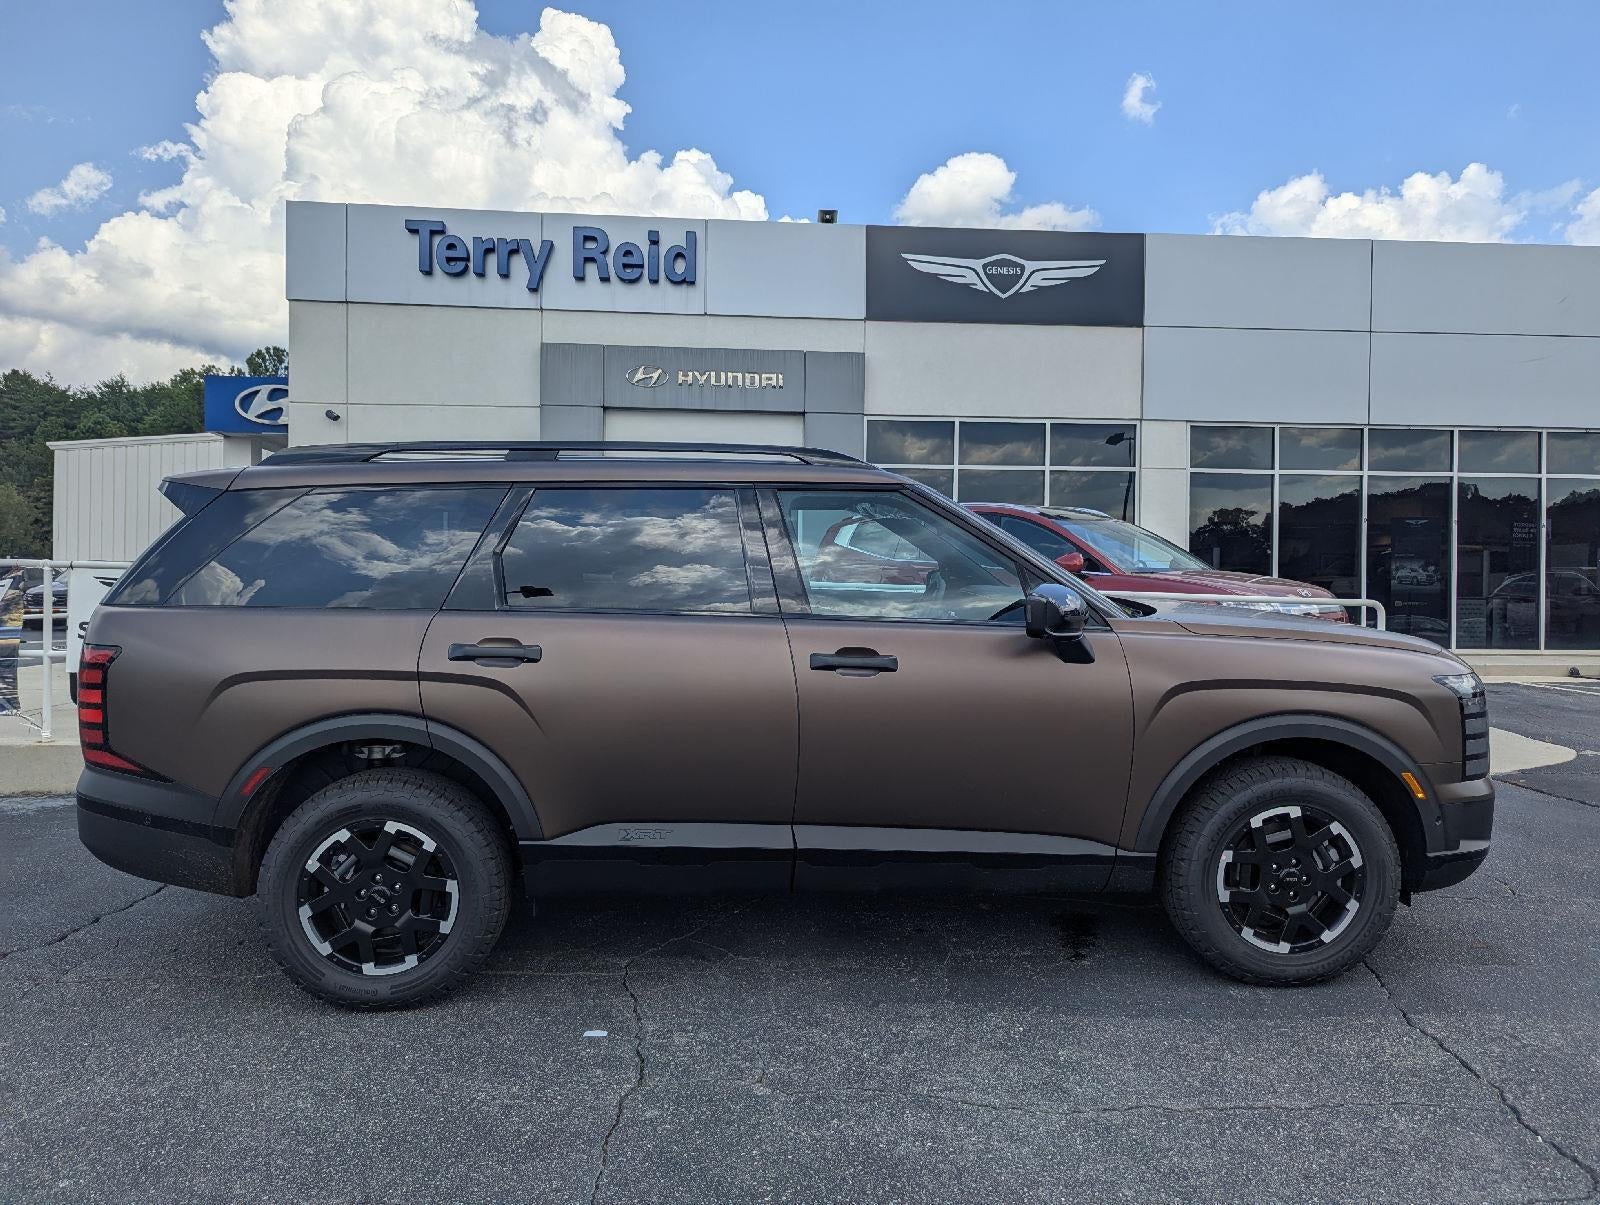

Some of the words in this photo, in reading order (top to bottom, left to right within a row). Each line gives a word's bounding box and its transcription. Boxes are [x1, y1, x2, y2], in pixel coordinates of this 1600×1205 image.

[404, 219, 554, 292] Terry
[572, 226, 698, 285] Reid
[986, 266, 1022, 275] GENESIS
[677, 370, 784, 389] HYUNDAI
